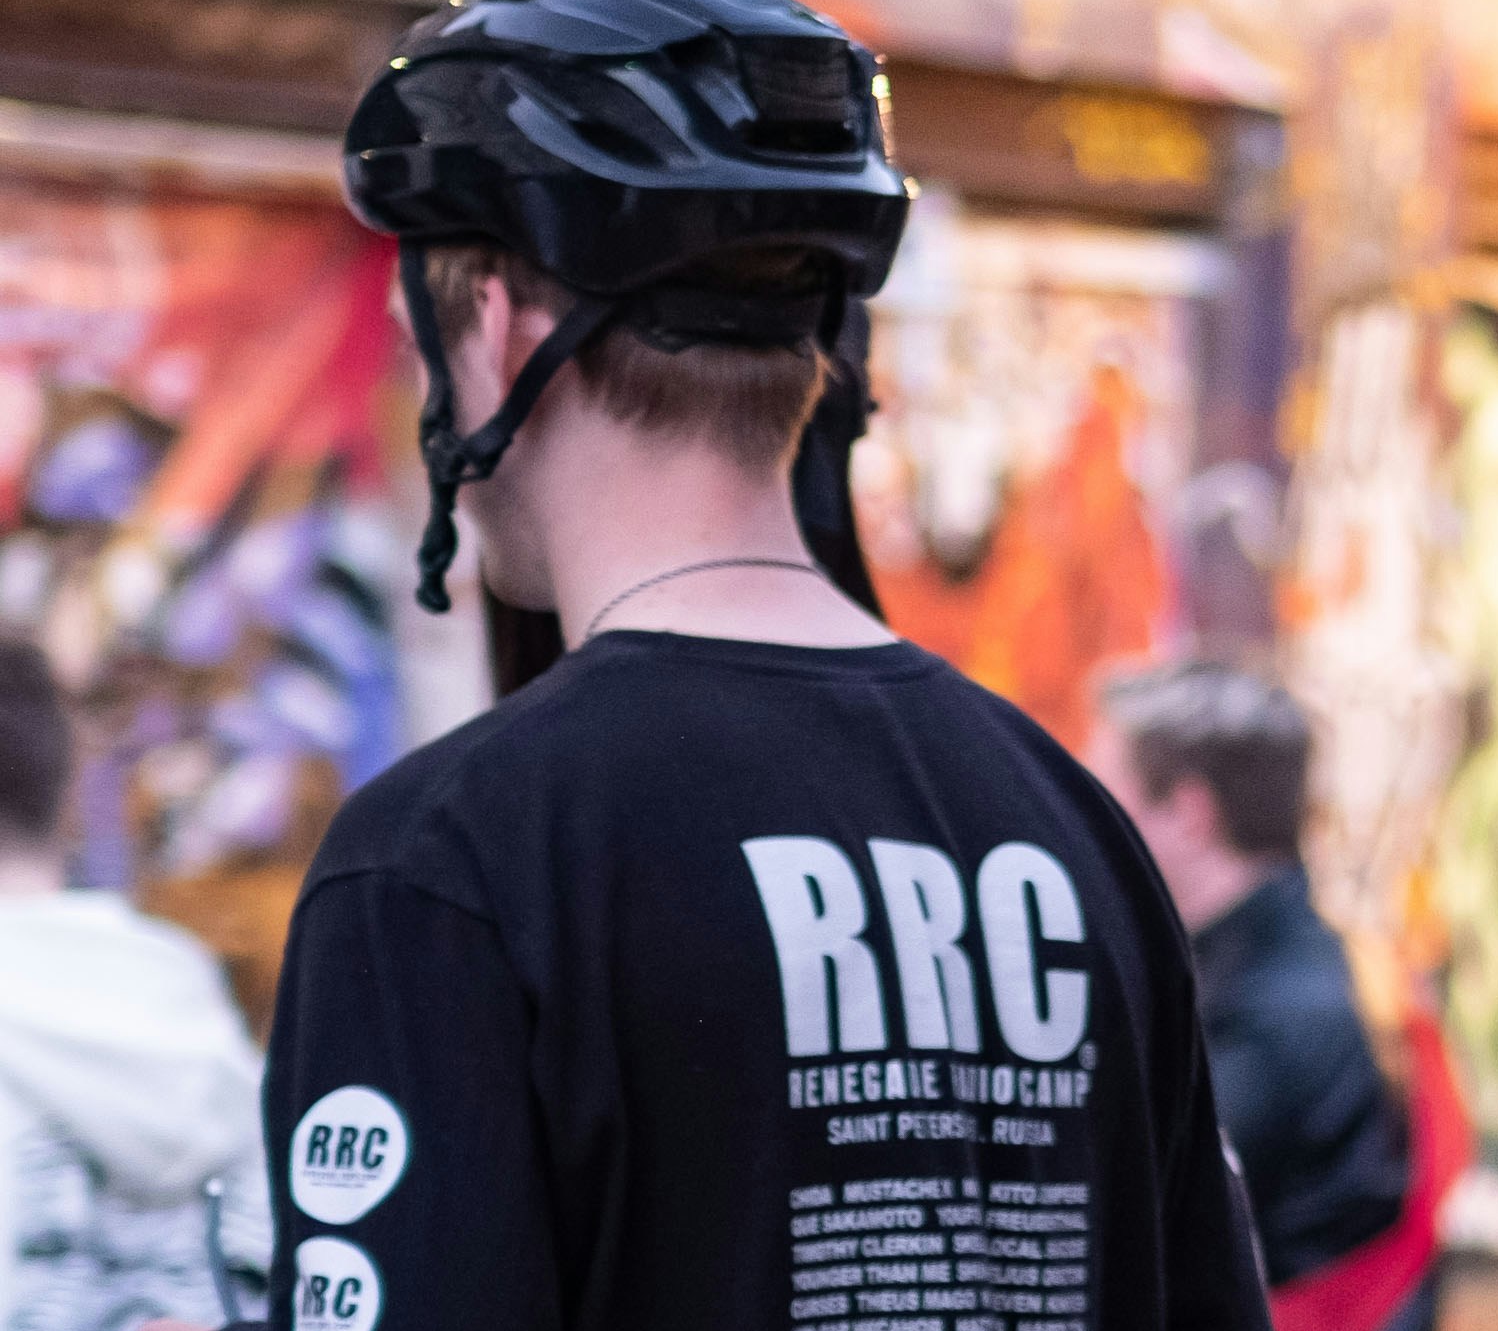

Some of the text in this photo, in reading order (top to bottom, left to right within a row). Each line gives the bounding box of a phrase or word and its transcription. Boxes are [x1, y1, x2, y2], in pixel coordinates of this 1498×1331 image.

[741, 834, 1090, 1064] RRC
[306, 1124, 389, 1169] RRC
[827, 1114, 891, 1147] SAINT
